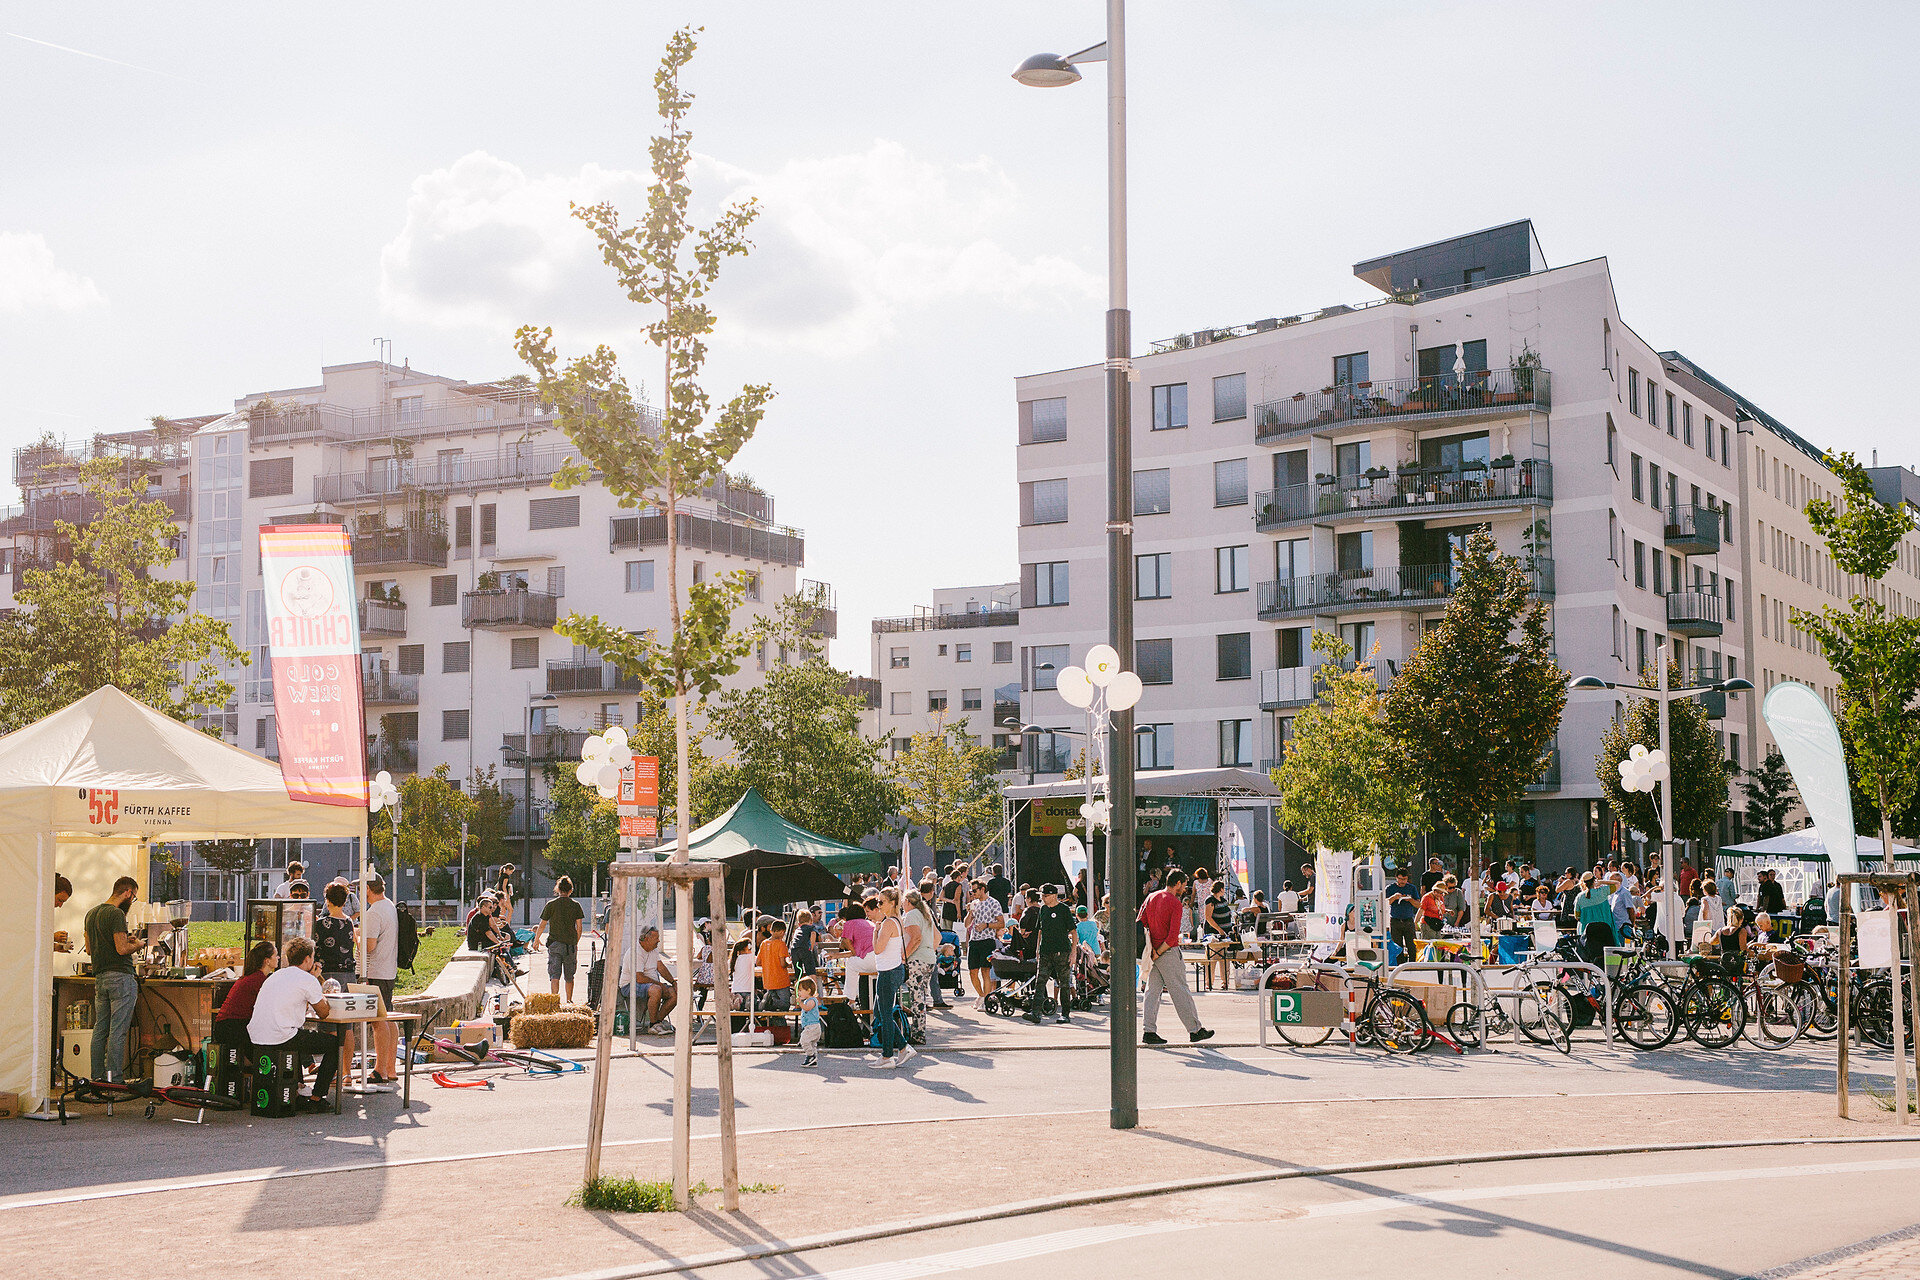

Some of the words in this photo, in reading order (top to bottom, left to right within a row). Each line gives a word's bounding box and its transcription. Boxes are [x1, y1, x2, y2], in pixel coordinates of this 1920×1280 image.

[124, 803, 154, 815] FÜRTH
[157, 807, 191, 816] KAFFEE
[1276, 995, 1295, 1021] P
[229, 1049, 237, 1064] now
[228, 1081, 236, 1096] now
